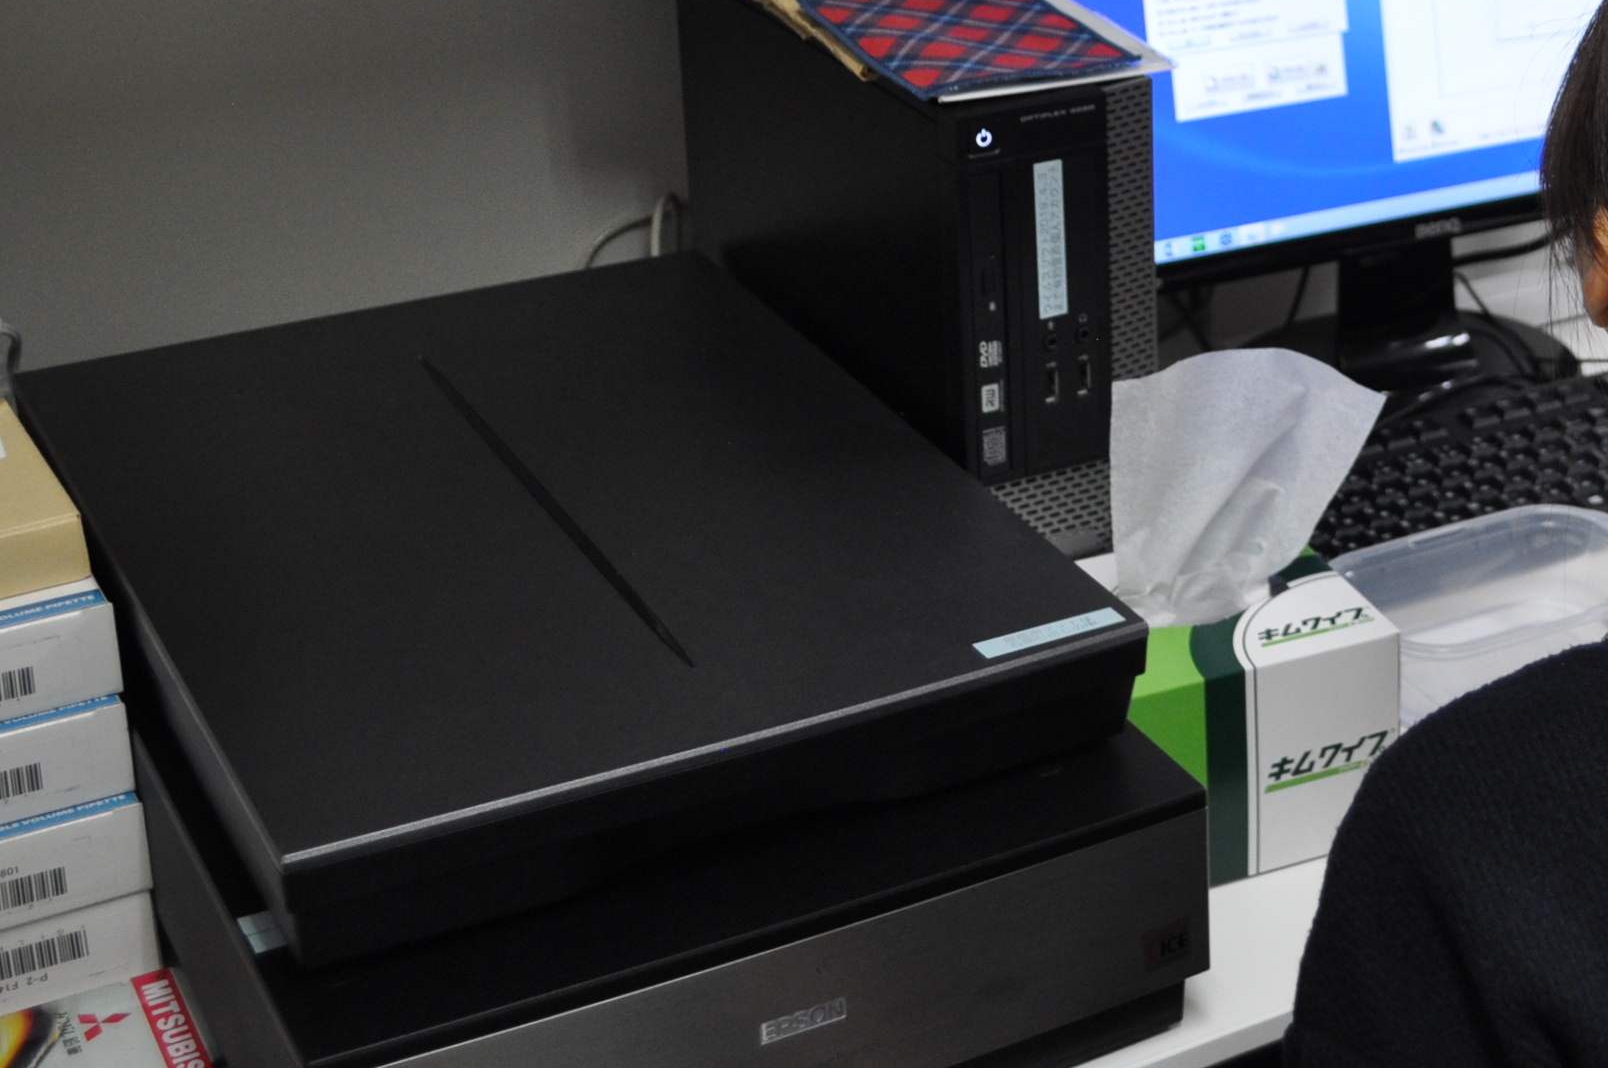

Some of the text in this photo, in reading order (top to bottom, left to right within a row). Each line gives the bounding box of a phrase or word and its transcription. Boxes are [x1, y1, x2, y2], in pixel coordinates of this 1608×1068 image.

[45, 594, 95, 609] PIPETTE
[1258, 606, 1370, 641] キムワイプ
[1267, 730, 1390, 781] キムワイプ
[21, 808, 75, 825] VOLUME
[77, 794, 126, 811] PIPETTE
[761, 997, 847, 1045] EPSON
